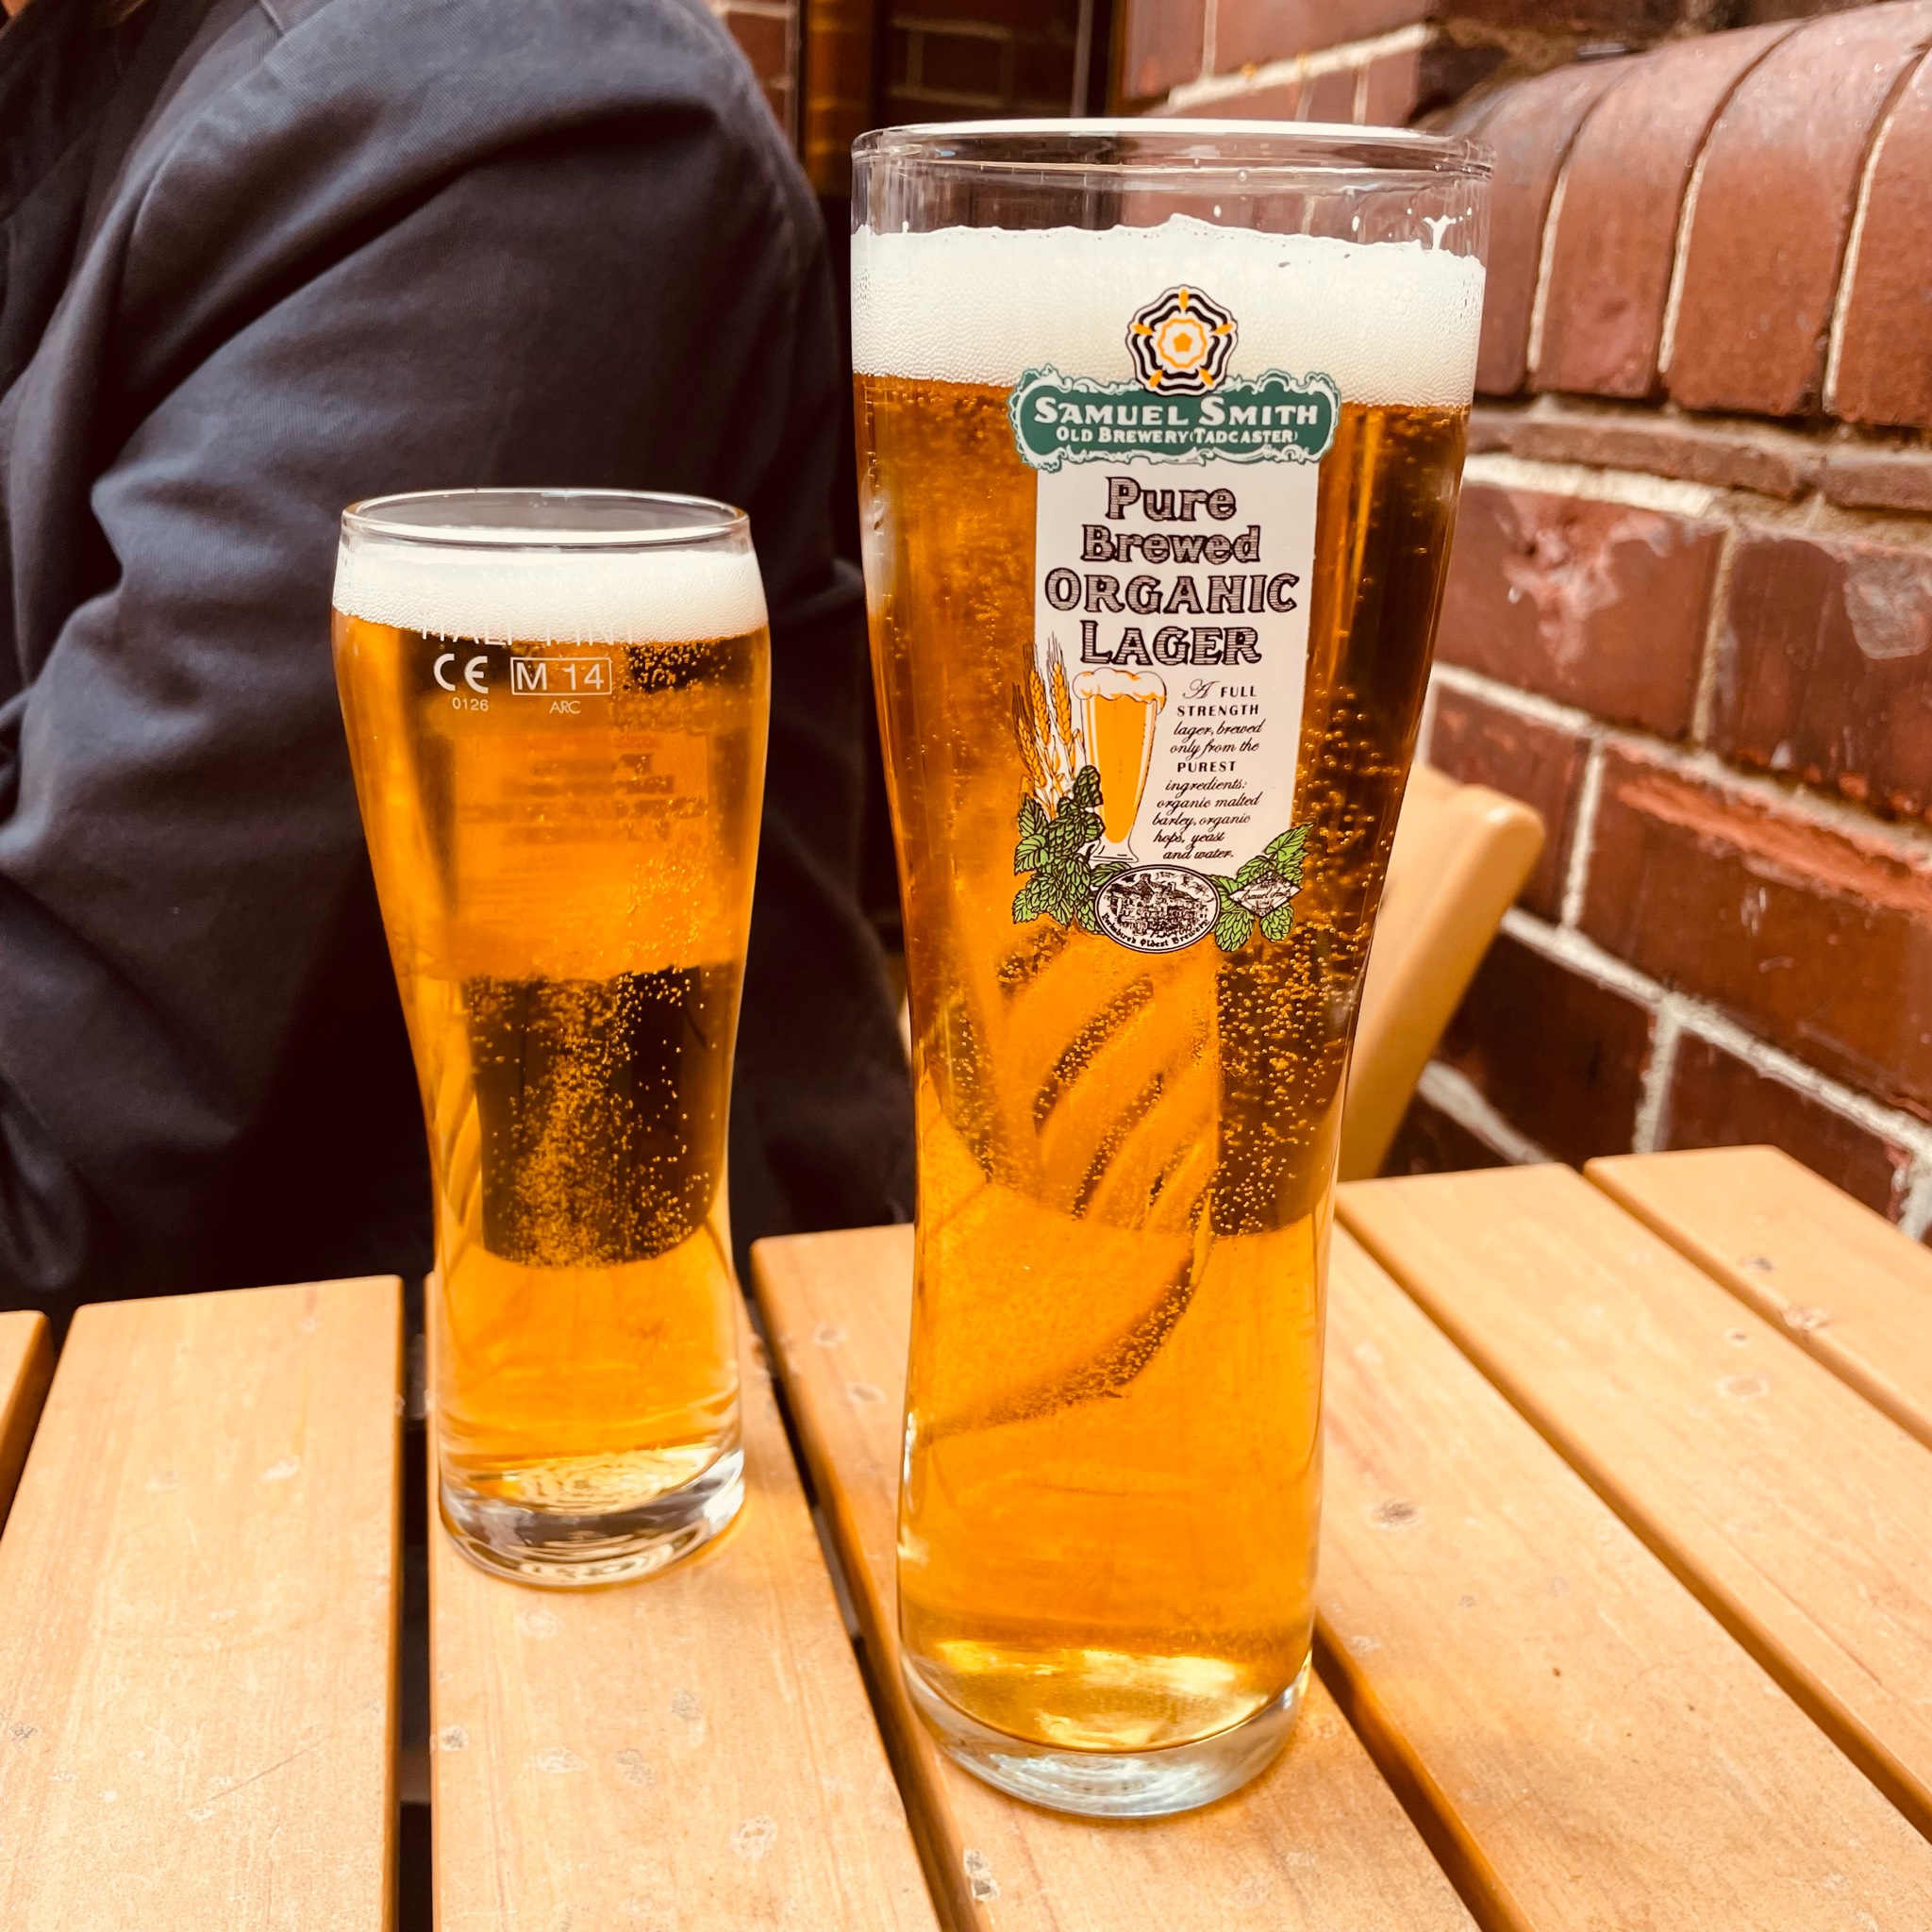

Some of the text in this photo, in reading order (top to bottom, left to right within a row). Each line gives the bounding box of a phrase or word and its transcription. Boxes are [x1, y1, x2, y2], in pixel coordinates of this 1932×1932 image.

[1034, 395, 1319, 425] SAMUEL SMITH
[1056, 427, 1091, 443] OLD
[1097, 426, 1190, 444] BREWERY
[1105, 476, 1238, 522] Pure
[1080, 525, 1261, 565] Brewed
[1044, 567, 1300, 614] ORGANIC
[1080, 620, 1262, 666] LAGER
[516, 662, 605, 691] M 14
[1182, 678, 1257, 699] A FULL
[452, 697, 489, 712] 0126
[549, 700, 581, 714] ARC
[1176, 705, 1259, 717] STRENGTH
[1174, 719, 1267, 743] lager, brewed
[1170, 738, 1260, 761] only from the
[1176, 760, 1238, 773] PUREST
[1165, 776, 1248, 798] ingredients:
[1157, 791, 1264, 816] organic malted
[1152, 812, 1252, 833] barley, organic
[1153, 829, 1225, 850] hops, yeast
[1162, 846, 1234, 859] and water.
[1140, 938, 1170, 948] Oldest
